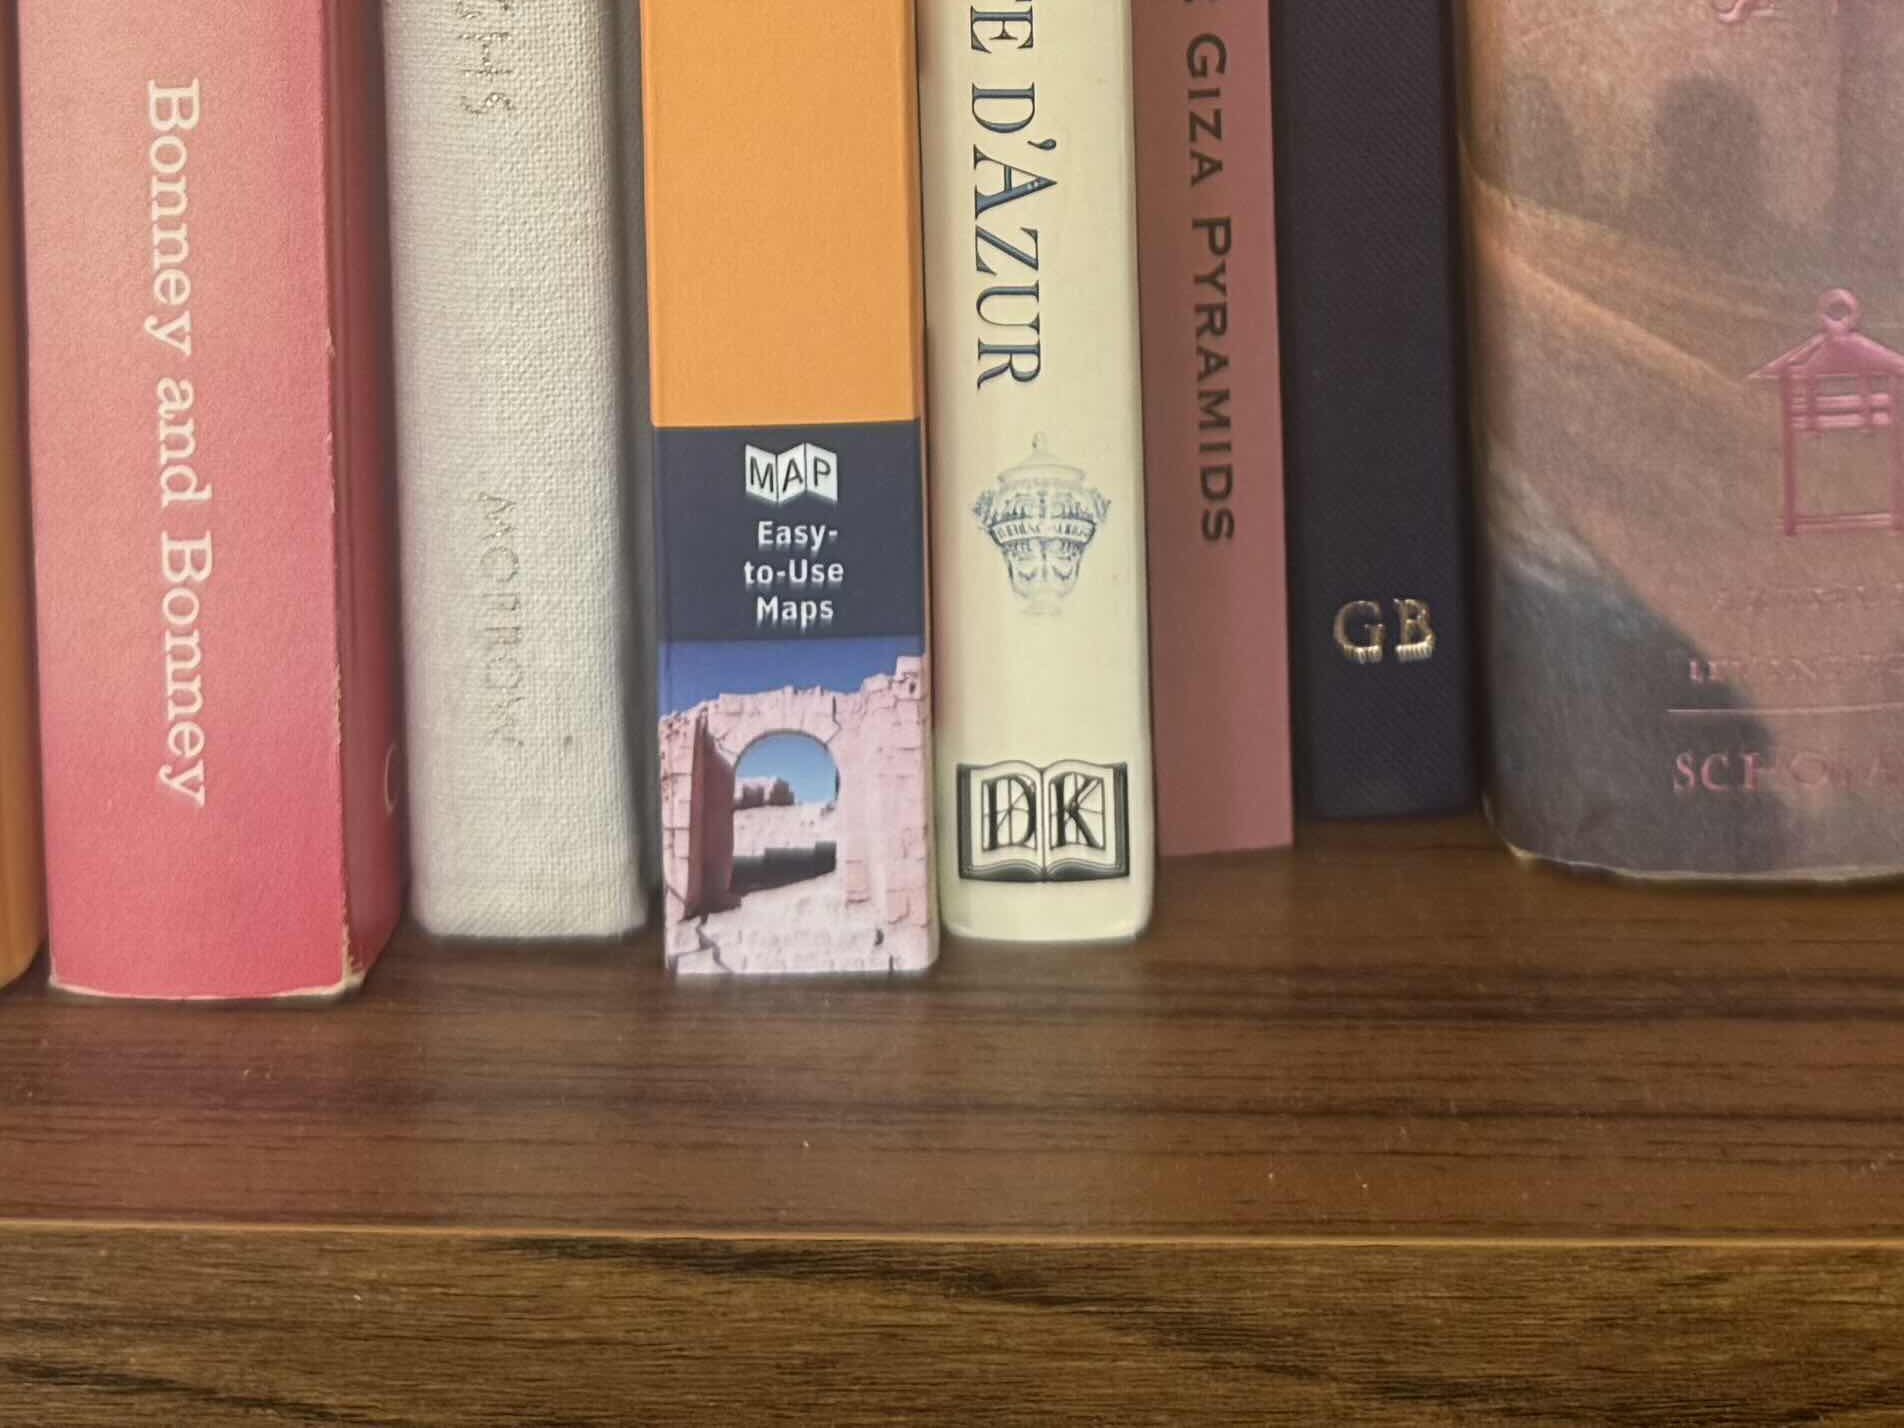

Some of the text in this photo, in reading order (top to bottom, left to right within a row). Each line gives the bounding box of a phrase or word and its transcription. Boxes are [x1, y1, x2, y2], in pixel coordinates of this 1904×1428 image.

[1186, 32, 1229, 186] GIZA
[1192, 216, 1240, 544] PYRAMIDS
[143, 76, 221, 809] Bonney and Bonney
[749, 455, 832, 493] MAP
[757, 520, 838, 554] Easy-
[744, 558, 844, 586] to-Use
[756, 596, 834, 630] Maps
[1334, 599, 1436, 664] GB
[981, 774, 1106, 852] DK
